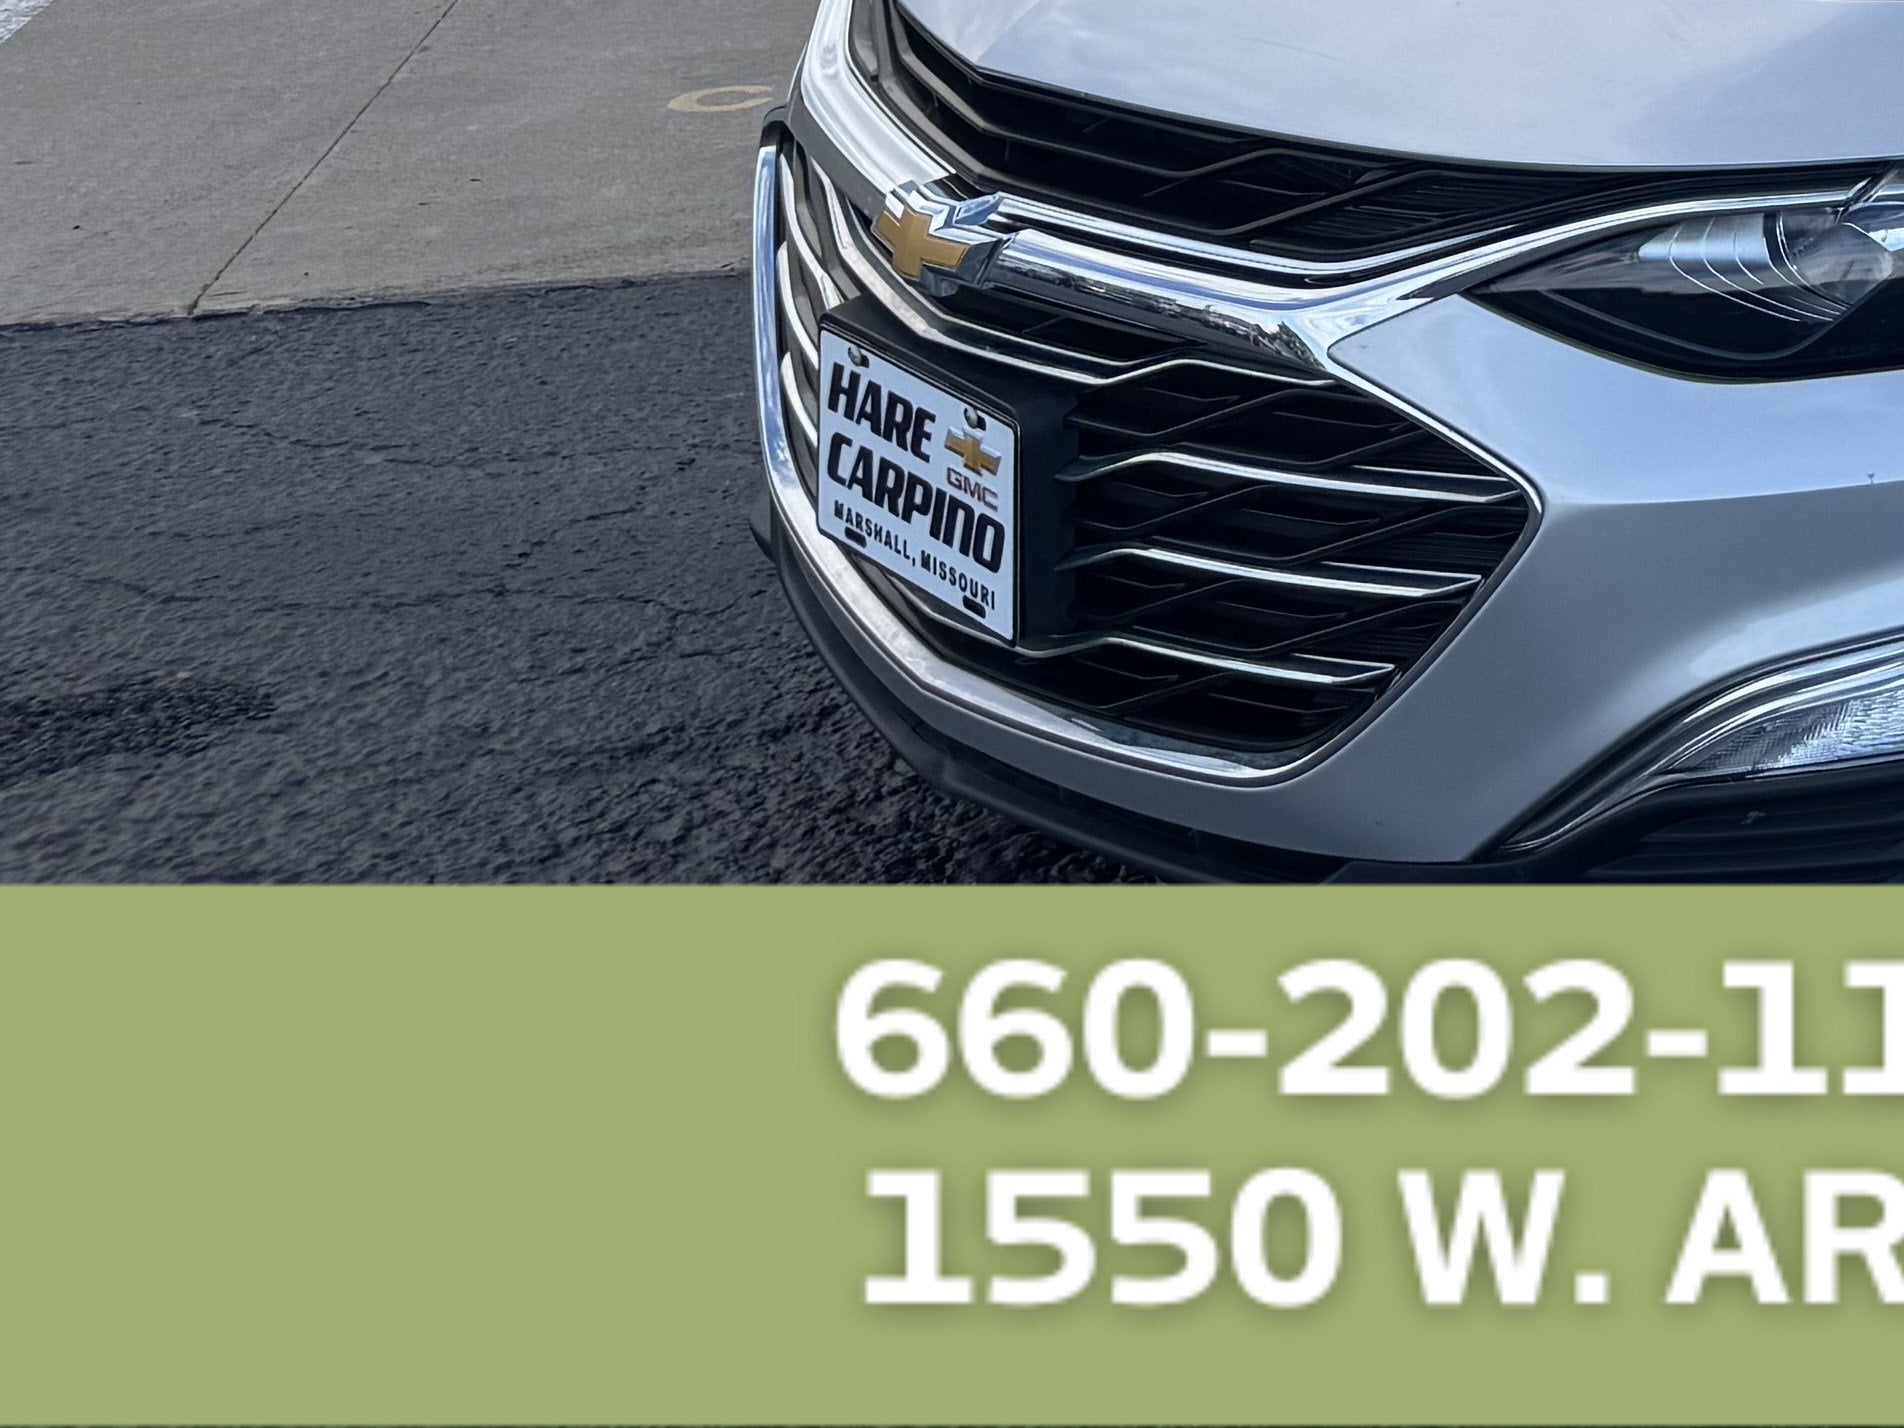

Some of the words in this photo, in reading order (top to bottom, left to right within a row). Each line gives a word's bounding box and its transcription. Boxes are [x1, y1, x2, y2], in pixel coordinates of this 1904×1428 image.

[827, 361, 937, 464] HARE
[826, 431, 1006, 574] CARPINO
[946, 466, 999, 513] GMC
[833, 498, 917, 568] MARSHALL,
[920, 548, 996, 611] MISSOURI
